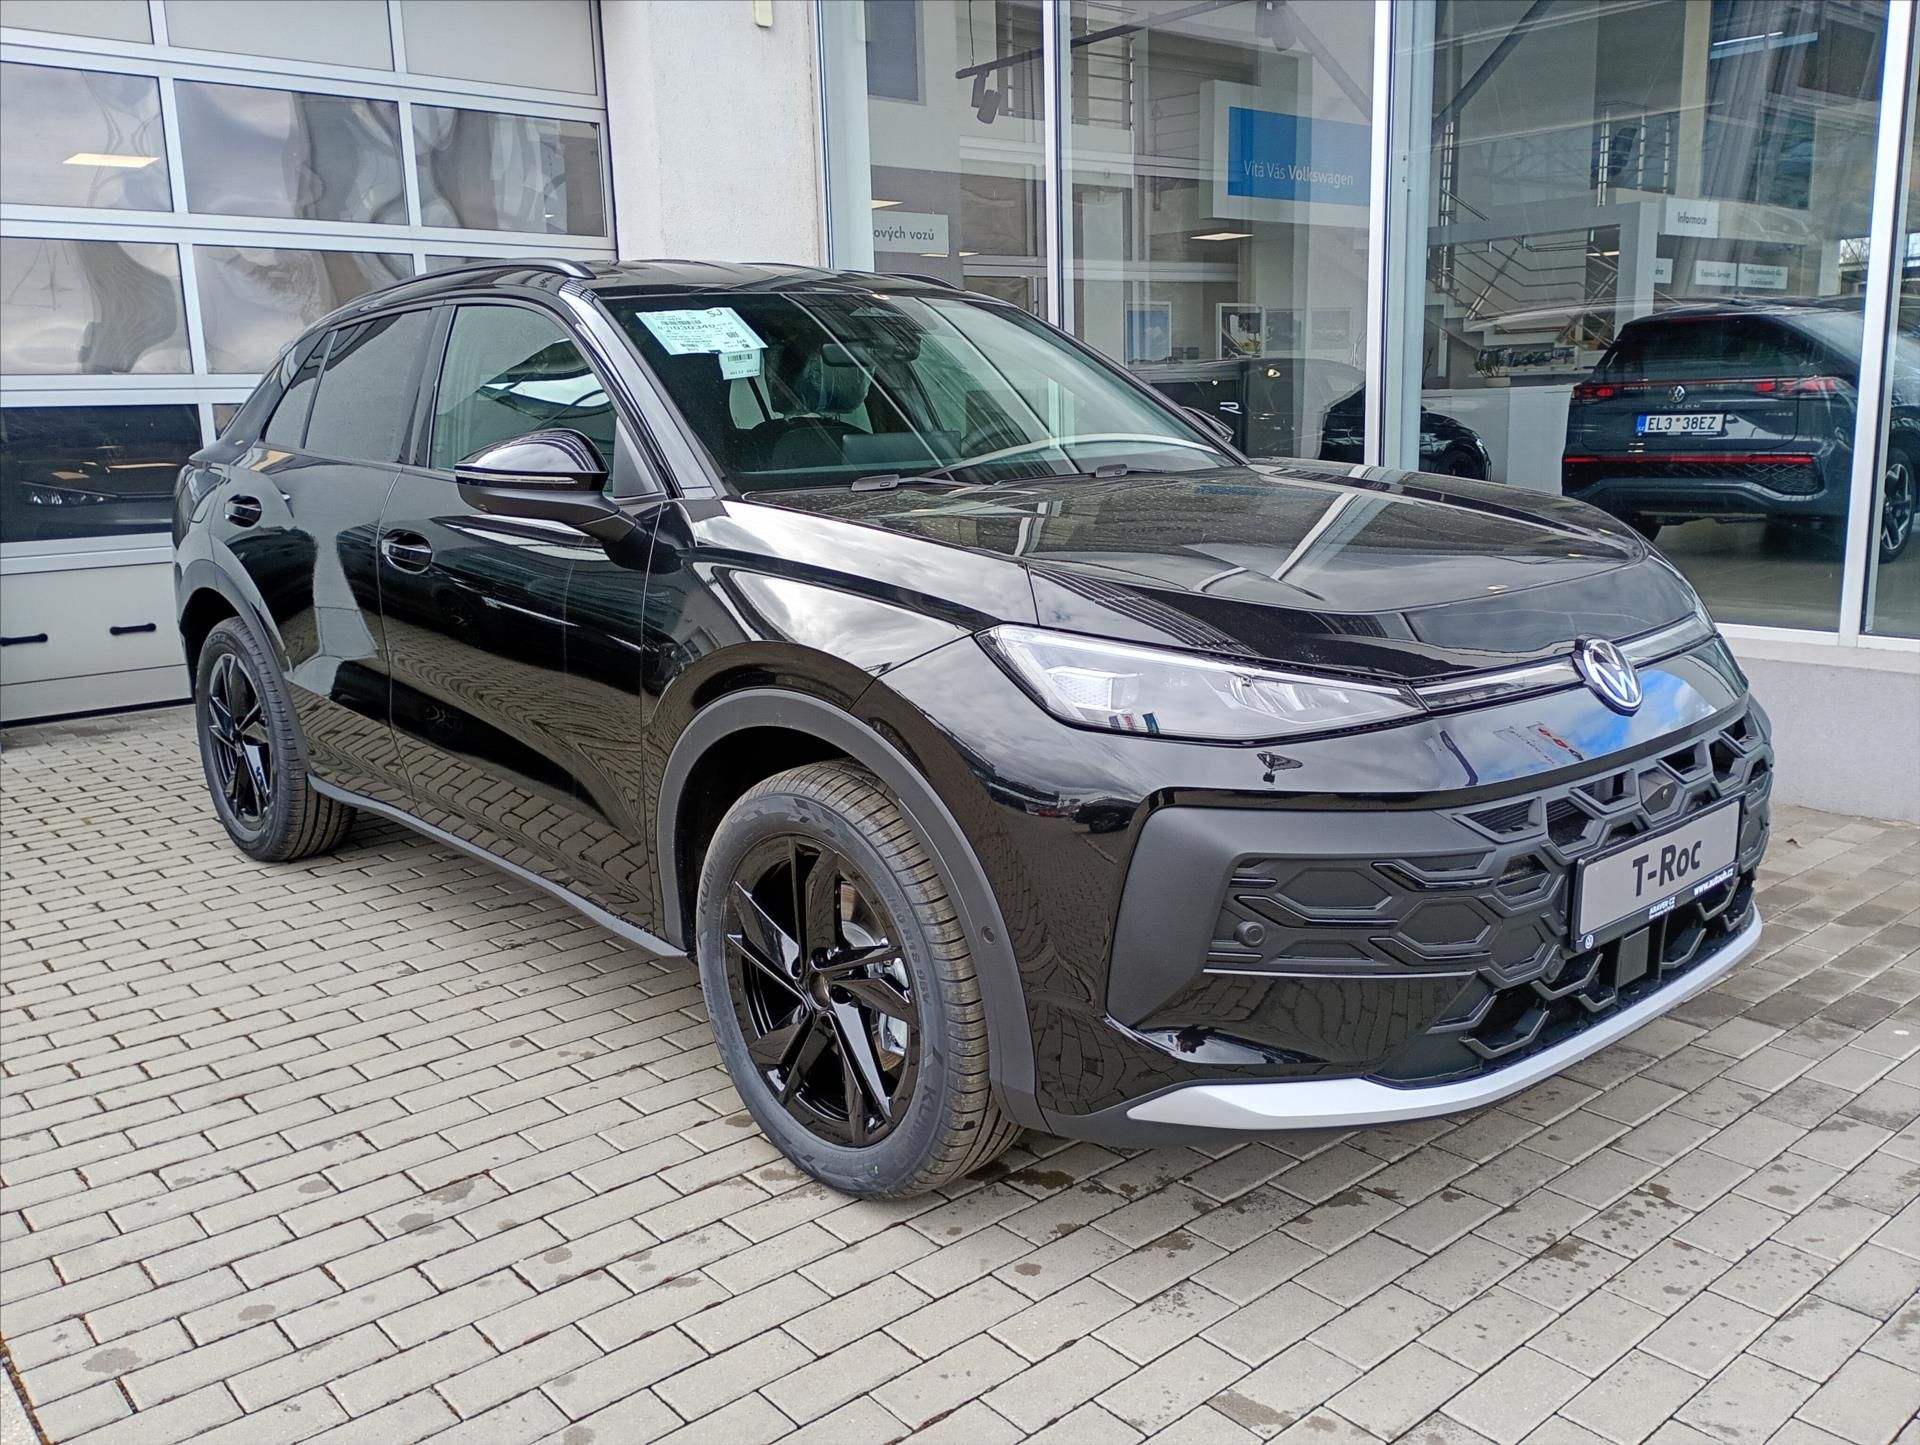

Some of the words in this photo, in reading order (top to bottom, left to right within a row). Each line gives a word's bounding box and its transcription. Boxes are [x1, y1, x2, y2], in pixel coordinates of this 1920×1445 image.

[1266, 161, 1286, 180] Vás
[1288, 164, 1354, 189] Volkswagen
[909, 228, 935, 241] vozů
[1647, 417, 1672, 431] EL3
[1682, 416, 1717, 431] 38EZ
[1632, 840, 1702, 897] T-Roc
